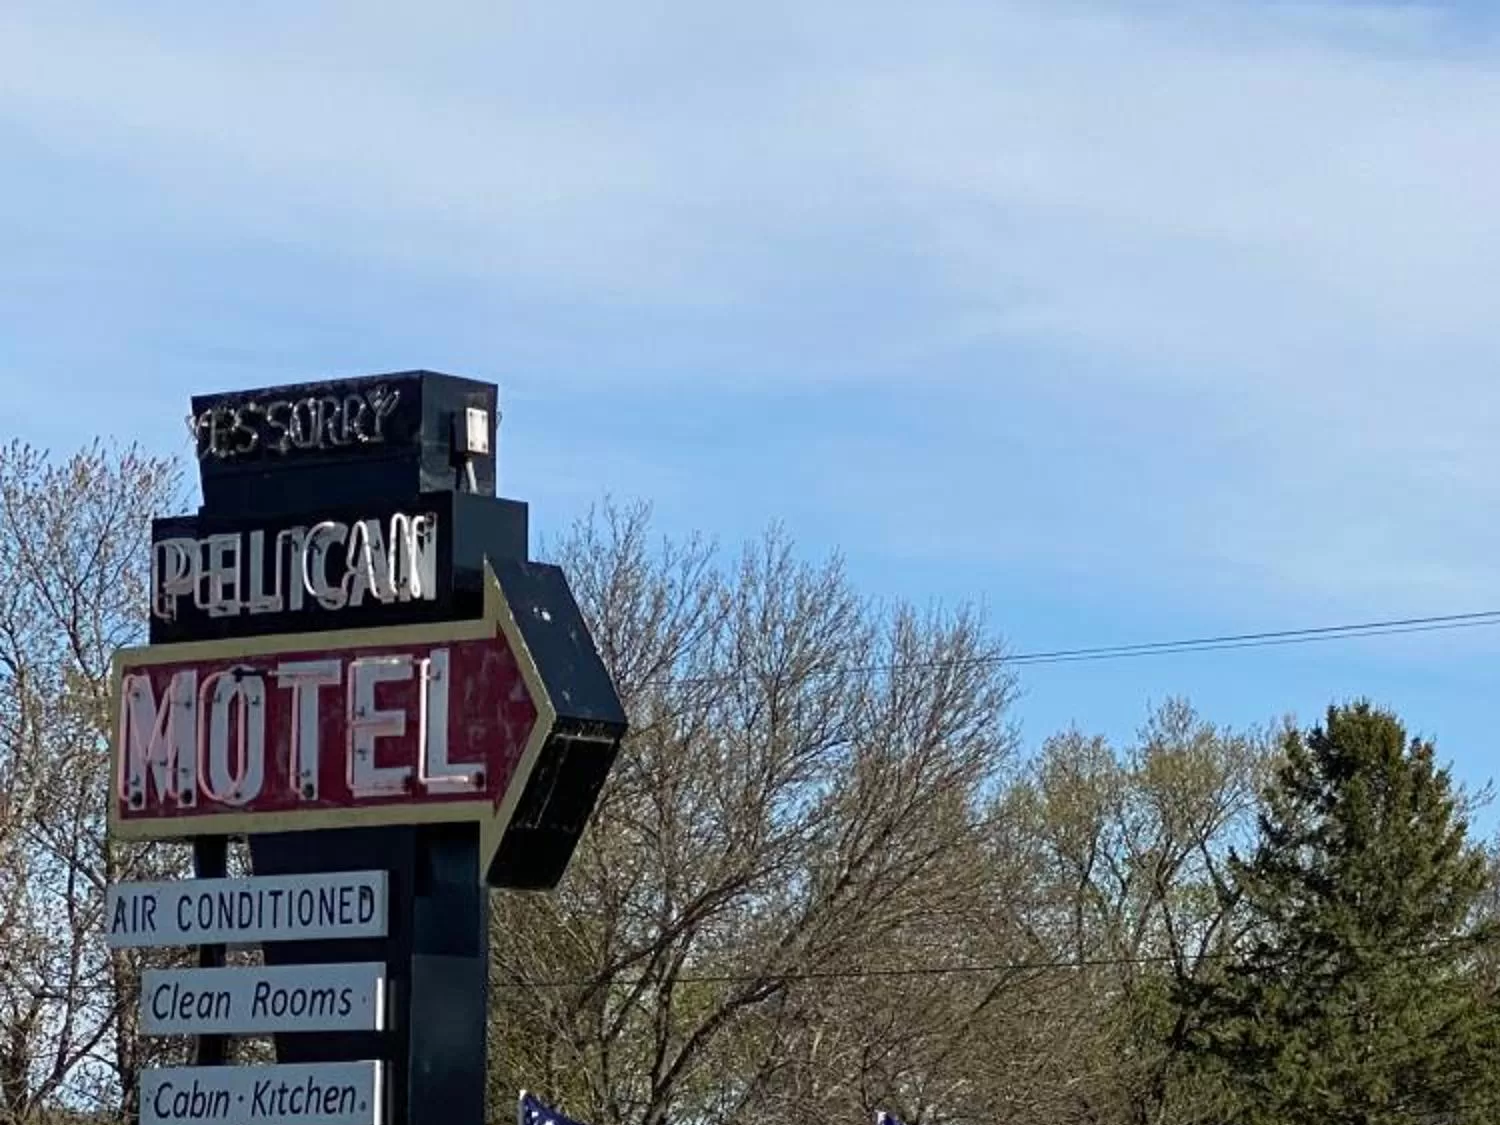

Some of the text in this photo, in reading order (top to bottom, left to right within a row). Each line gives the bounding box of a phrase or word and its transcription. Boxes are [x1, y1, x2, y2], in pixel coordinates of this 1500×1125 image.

[266, 385, 400, 454] SORRY
[153, 513, 437, 622] PELICAN
[118, 648, 487, 810] MOTEL
[111, 885, 375, 934] AIR CONDITIONED
[151, 980, 353, 1020] Clean Rooms
[152, 1075, 357, 1119] Cabin Kitchen
